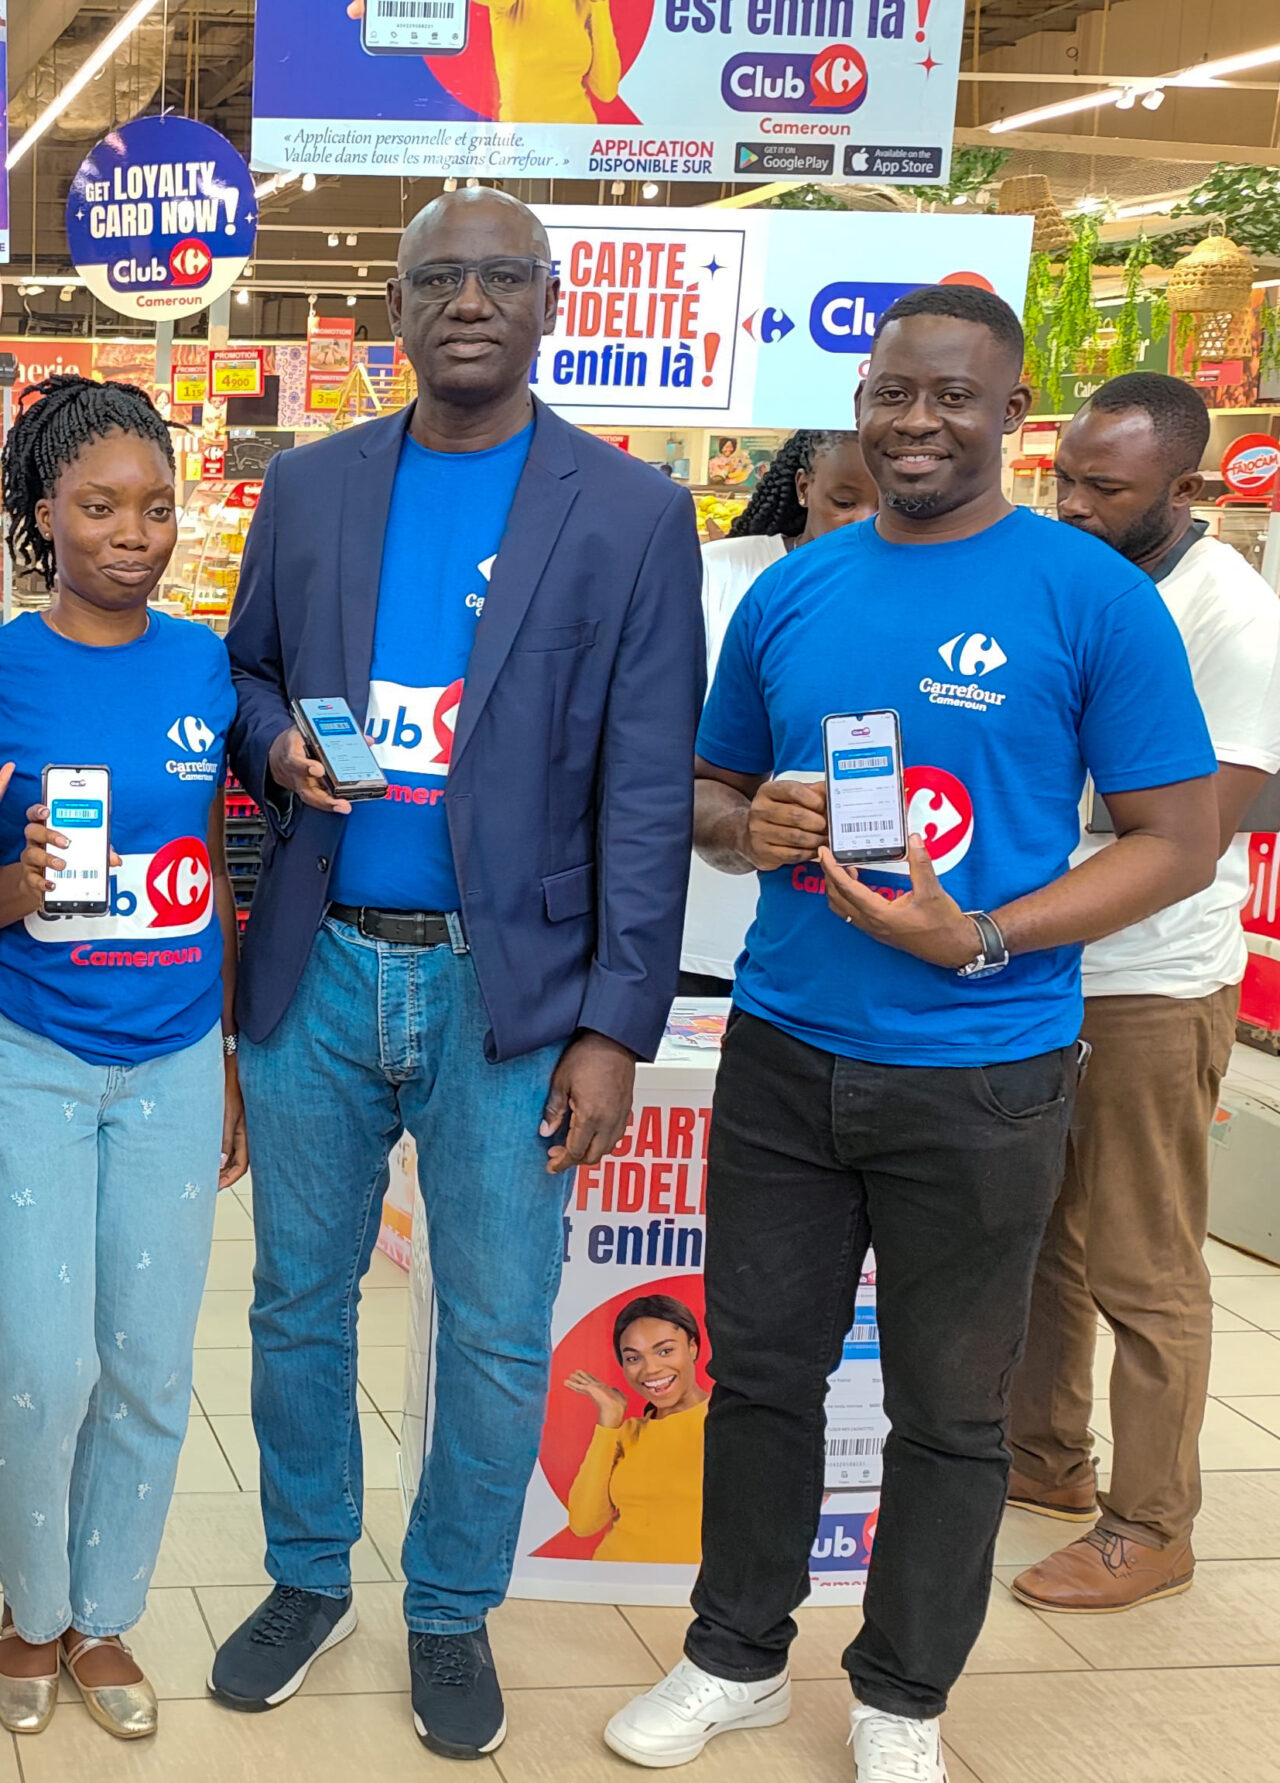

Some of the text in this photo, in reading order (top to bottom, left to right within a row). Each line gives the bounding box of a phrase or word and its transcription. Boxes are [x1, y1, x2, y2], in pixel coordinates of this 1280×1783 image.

[730, 64, 805, 99] Club
[759, 117, 852, 136] Cameroun
[293, 126, 372, 148] Application
[374, 128, 452, 149] personnelle
[454, 131, 468, 146] et
[467, 132, 525, 151] gratuite.
[589, 139, 715, 158] APPLICATION
[284, 146, 333, 163] Valable
[334, 146, 368, 164] dans
[371, 149, 400, 164] tous
[402, 147, 420, 164] les
[422, 151, 486, 170] magasins
[488, 149, 554, 171] Carrefour
[763, 146, 777, 155] GET
[874, 149, 907, 158] Available
[918, 150, 932, 159] the
[588, 158, 713, 175] DISPONIBLE SUR
[763, 155, 830, 172] Google Play
[873, 159, 934, 175] App Store
[85, 160, 216, 203] GET LOYALTY
[90, 202, 154, 240] CARD
[113, 257, 168, 283] Club
[569, 240, 687, 290] CARTE
[136, 295, 203, 308] Cameroun
[214, 351, 259, 360] PROMOTION
[552, 343, 648, 387] enfin
[919, 677, 1007, 706] Carrefour
[928, 693, 988, 712] Cameroun
[165, 757, 218, 774] Carrefour
[70, 943, 203, 968] Cameroun
[587, 1217, 704, 1267] enfin
